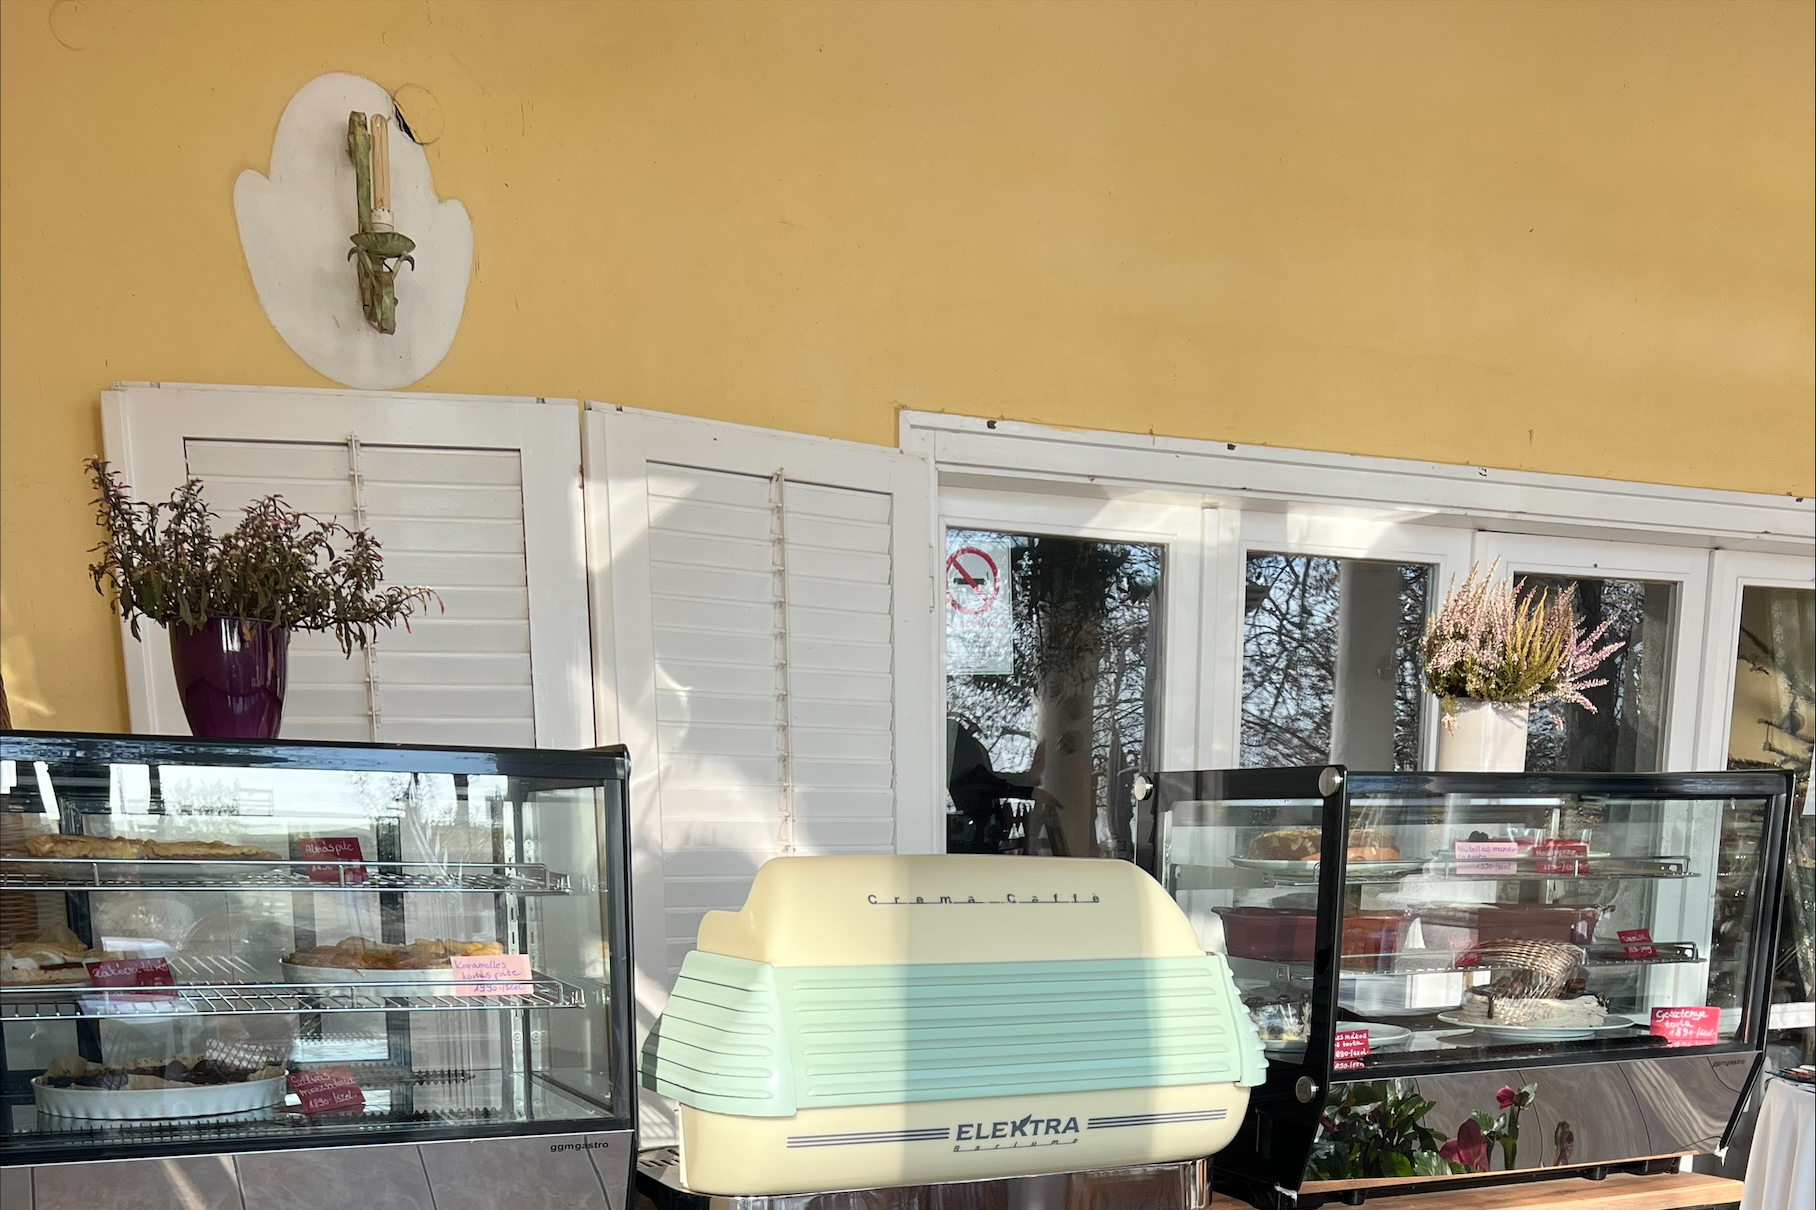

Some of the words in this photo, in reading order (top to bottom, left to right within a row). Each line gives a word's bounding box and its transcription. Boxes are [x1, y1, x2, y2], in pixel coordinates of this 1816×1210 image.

[867, 893, 976, 905] Crema
[1006, 892, 1100, 905] Caffè
[1655, 1008, 1709, 1023] Gesztenye
[1664, 1019, 1695, 1029] torta
[956, 1113, 1080, 1142] ELEKTRA
[550, 1141, 609, 1153] ggmgastro
